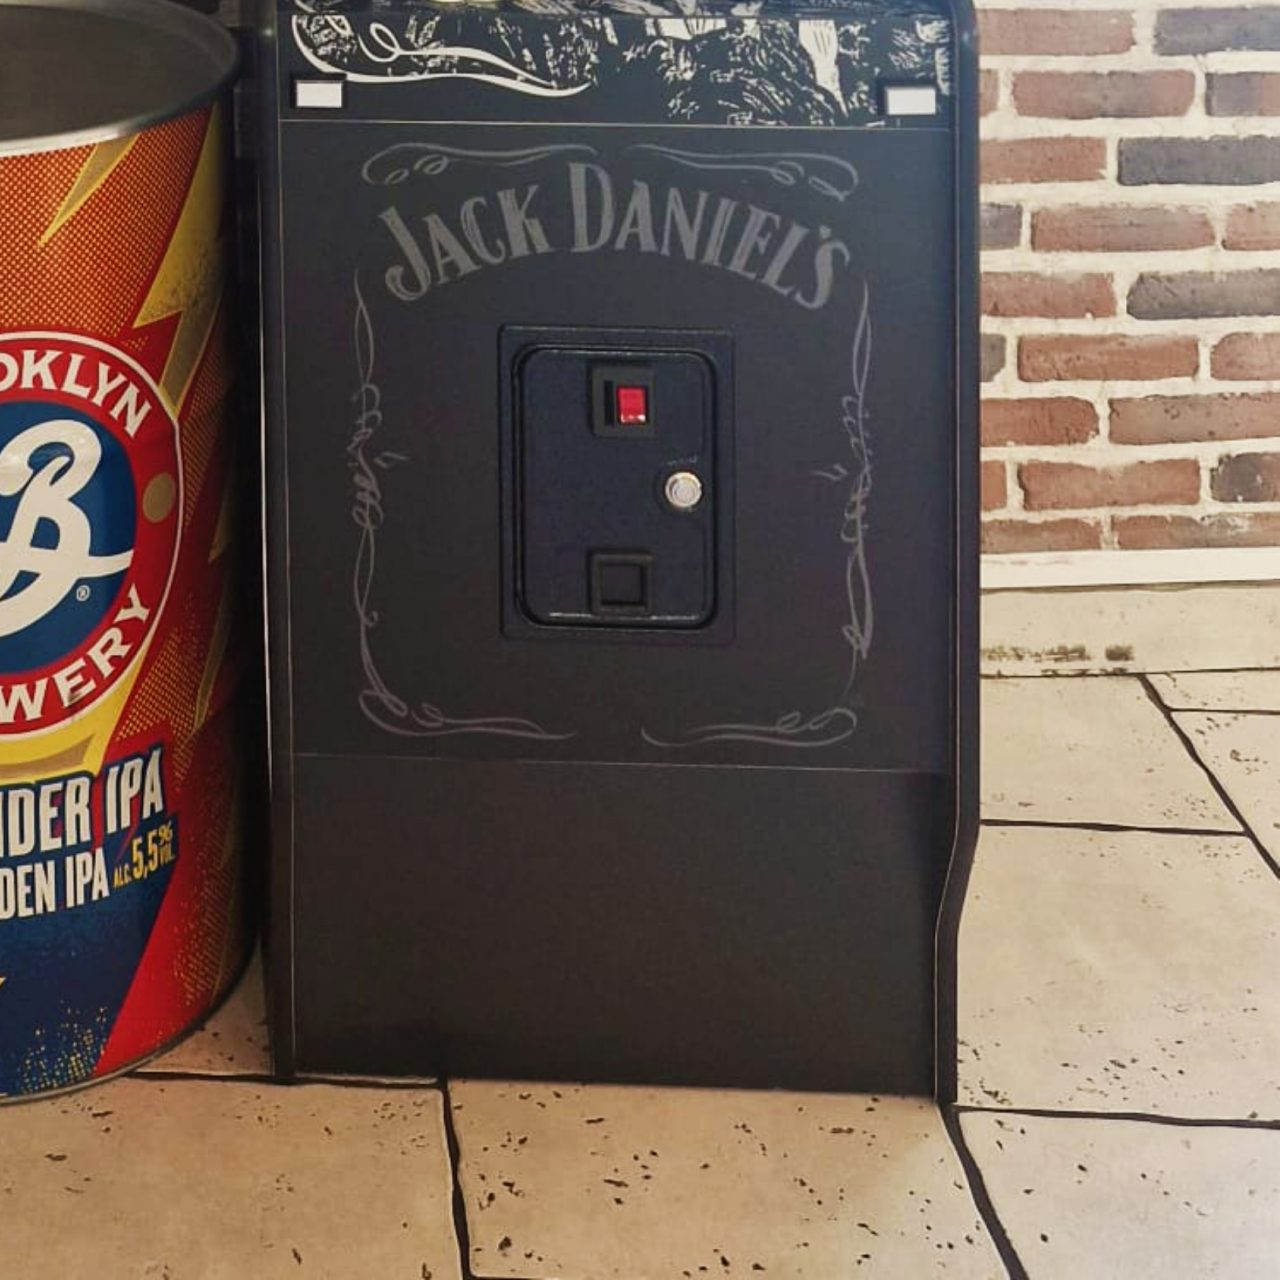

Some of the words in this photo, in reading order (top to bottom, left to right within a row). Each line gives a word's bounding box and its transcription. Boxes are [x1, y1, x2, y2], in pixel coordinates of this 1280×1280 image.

[378, 182, 557, 302] JACK
[567, 161, 852, 310] DANIEL'S
[104, 749, 165, 835] IPA
[64, 846, 111, 909] IPA
